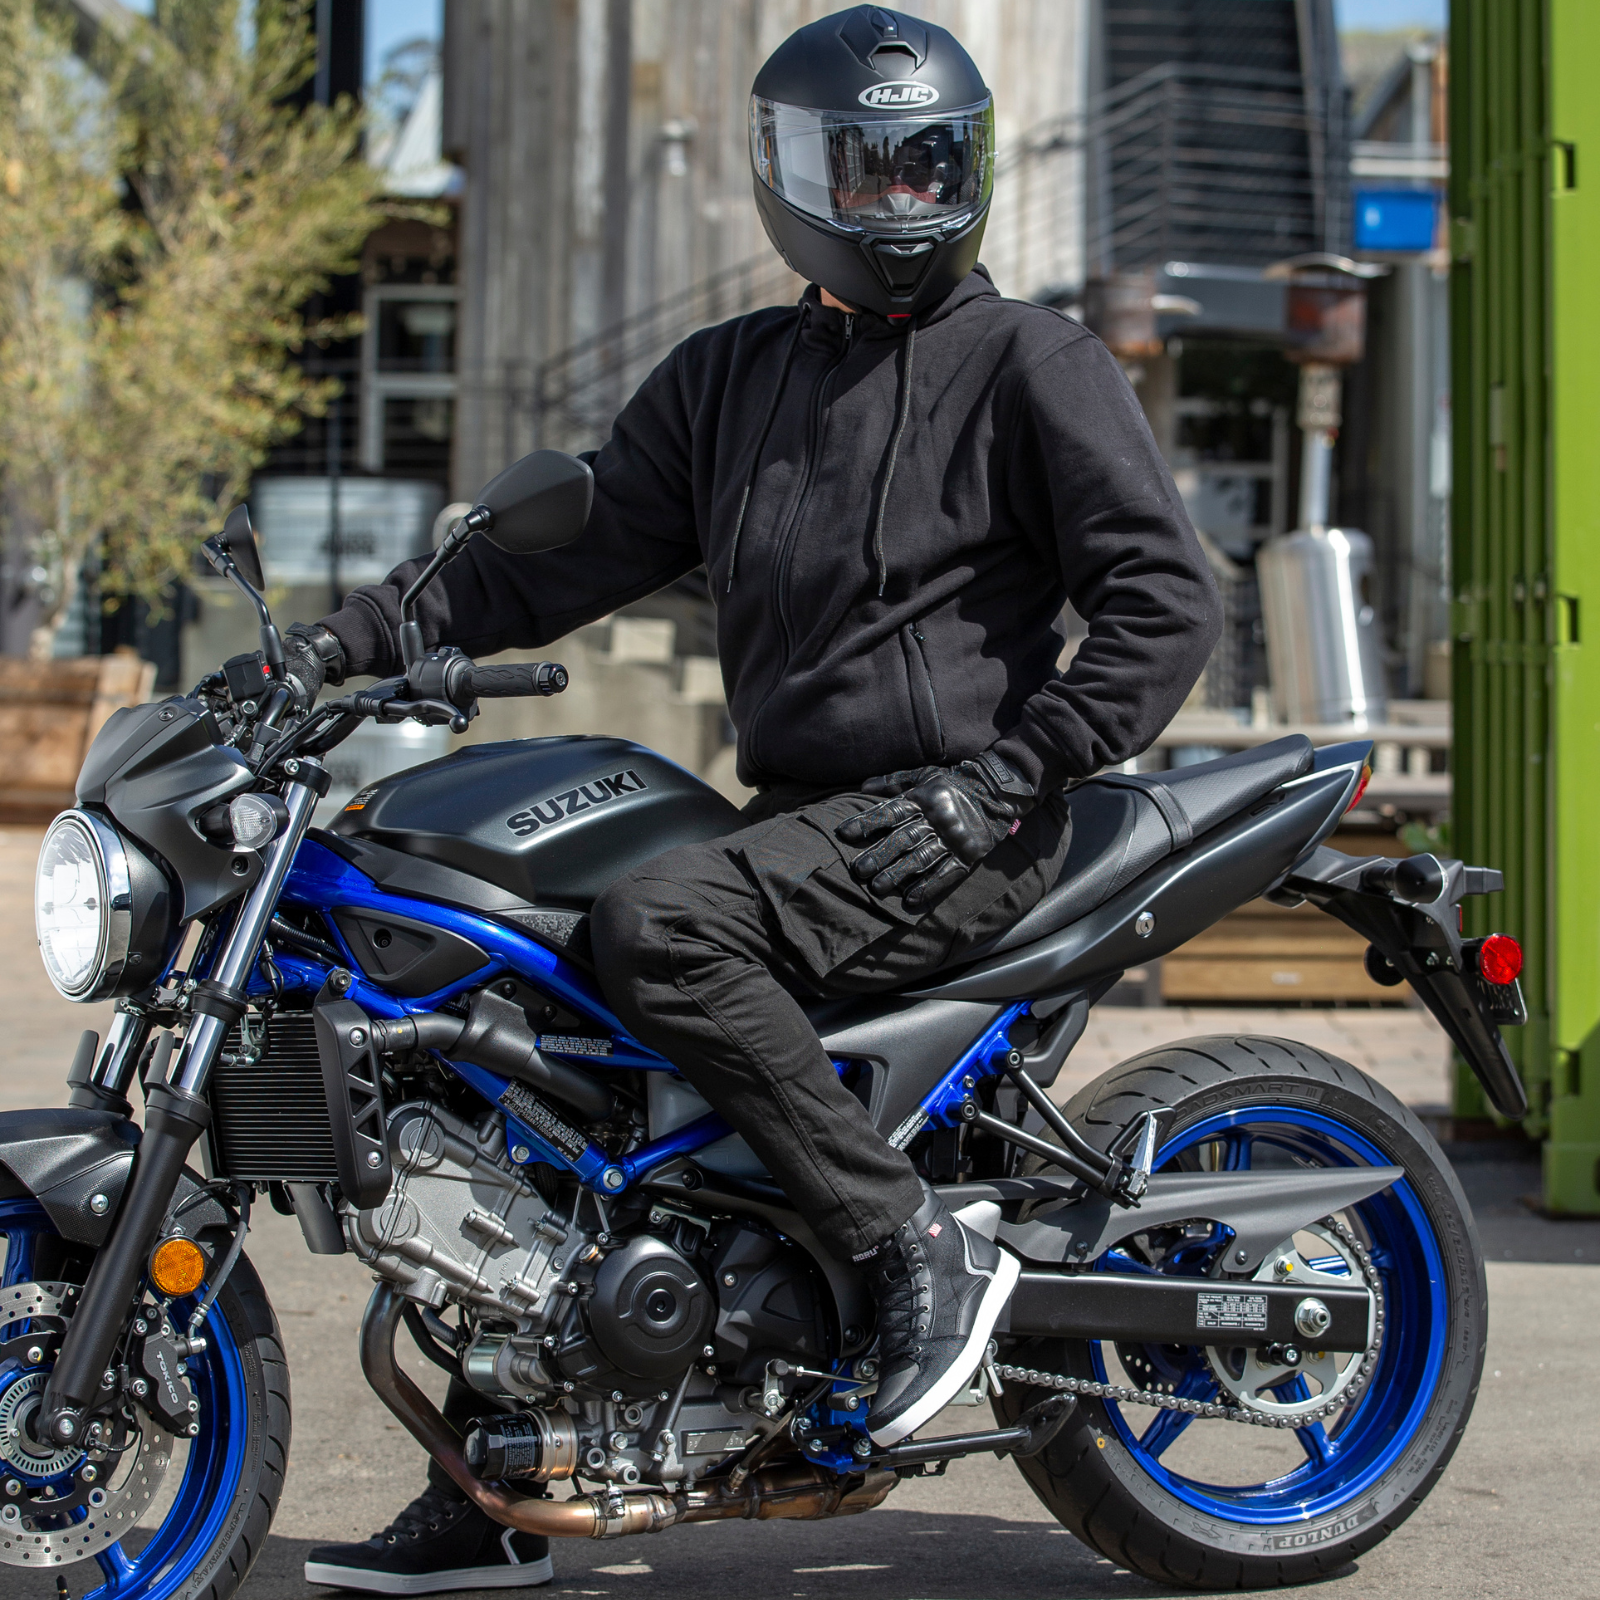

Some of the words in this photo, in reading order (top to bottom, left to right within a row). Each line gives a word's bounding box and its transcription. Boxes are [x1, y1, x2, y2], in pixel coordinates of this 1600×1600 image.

[869, 87, 929, 104] HJC
[506, 769, 648, 837] SUZUKI
[1175, 1081, 1300, 1120] OADSMART
[852, 1248, 878, 1262] NORU
[156, 1351, 178, 1404] TOKICO
[1278, 1514, 1360, 1548] DUNLOP
